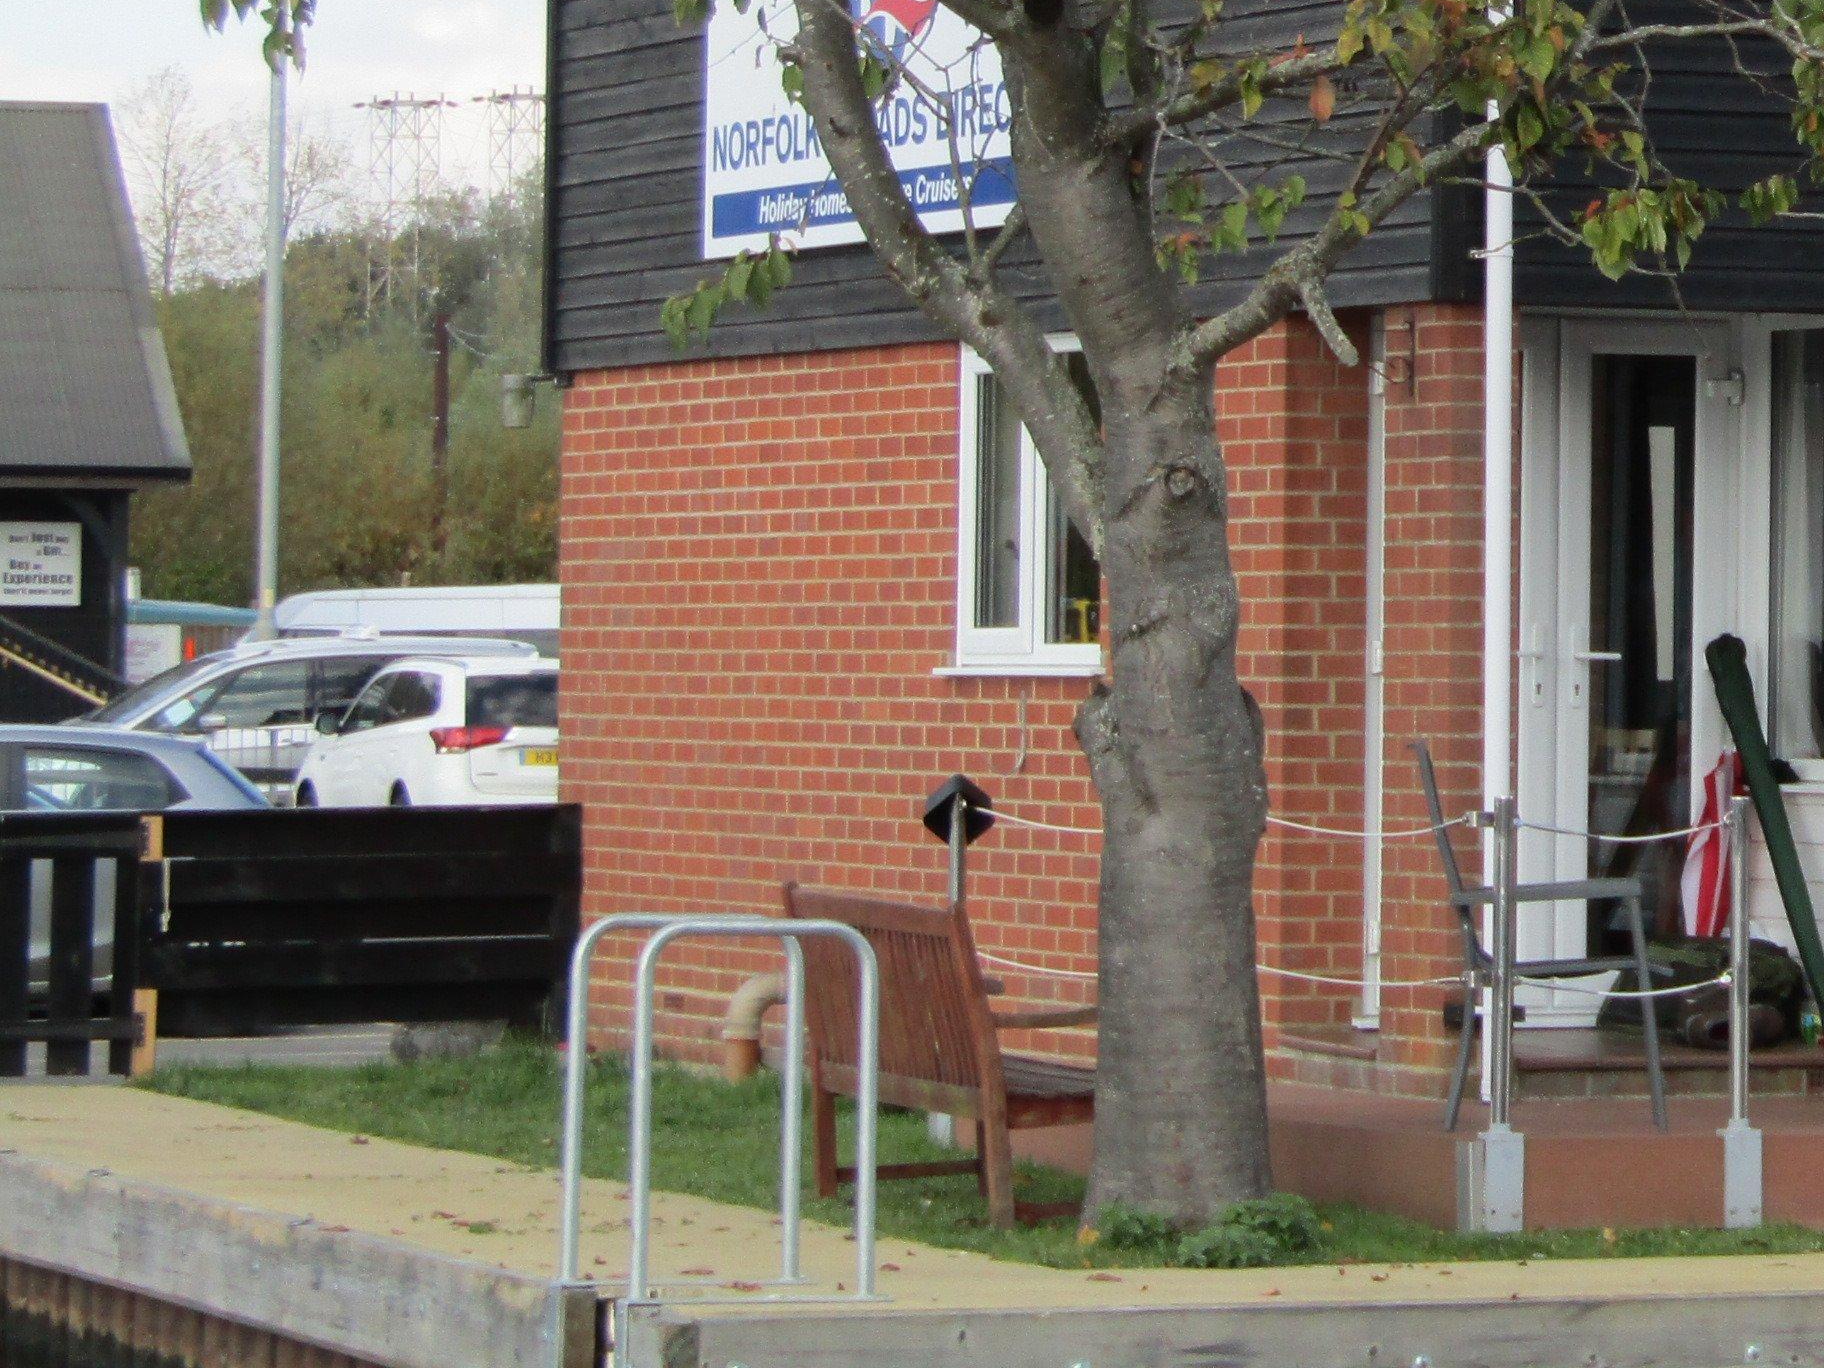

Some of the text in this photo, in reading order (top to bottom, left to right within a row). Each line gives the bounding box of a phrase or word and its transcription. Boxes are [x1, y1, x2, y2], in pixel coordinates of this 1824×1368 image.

[713, 113, 821, 172] NORFOLK
[936, 81, 1013, 141] DIREC
[759, 192, 808, 226] Holiday
[915, 172, 973, 205] Cruises
